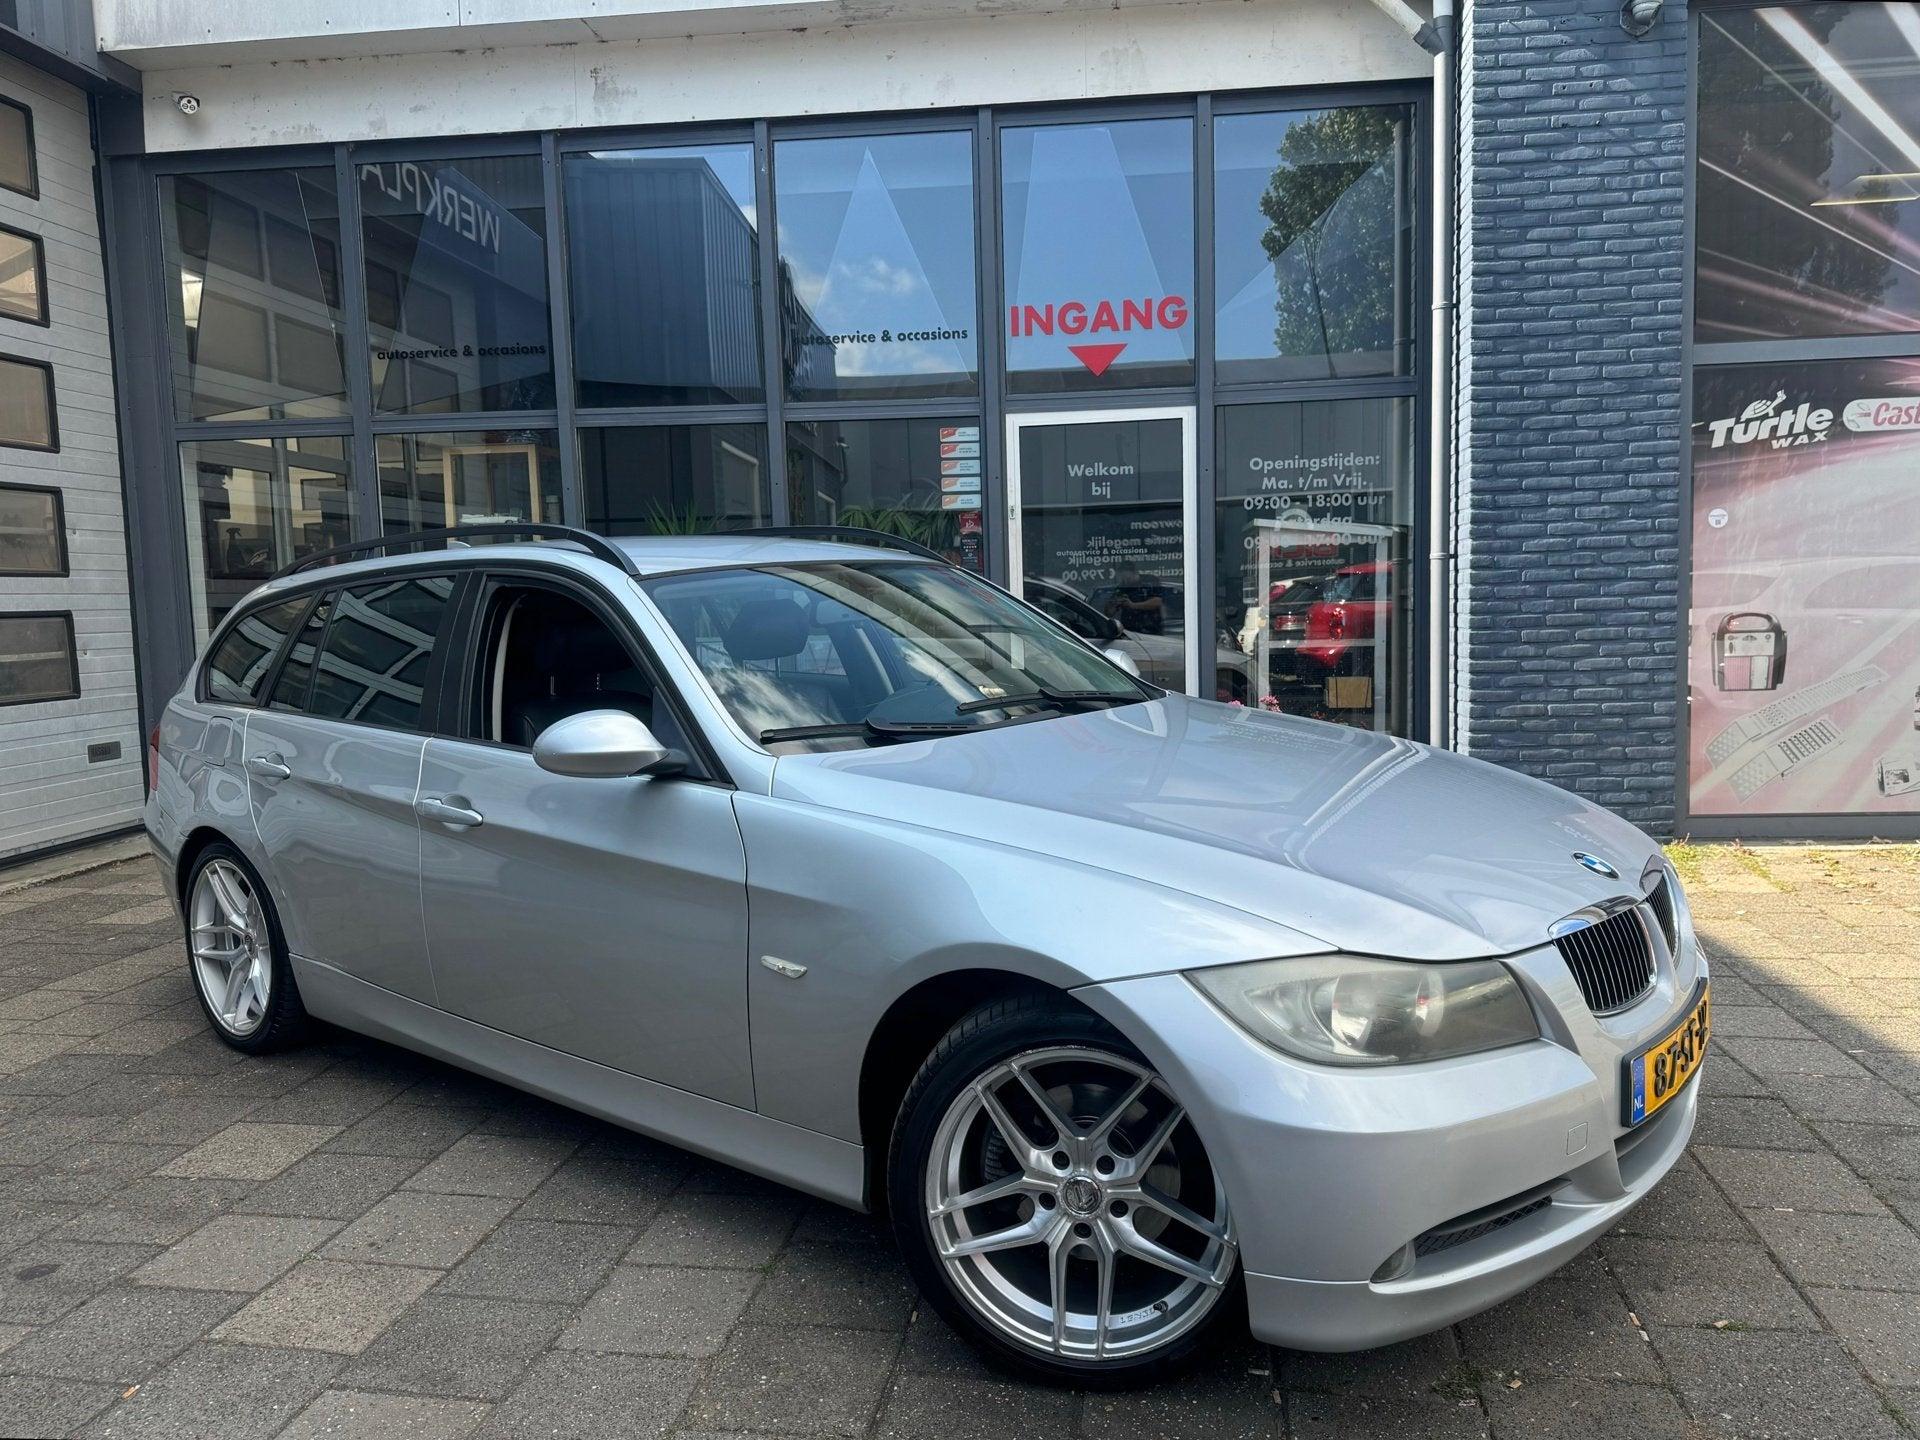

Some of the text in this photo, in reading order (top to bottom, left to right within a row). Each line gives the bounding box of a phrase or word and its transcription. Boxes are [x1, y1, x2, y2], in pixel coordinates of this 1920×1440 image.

[1010, 296, 1188, 337] INGANG
[794, 327, 968, 346] autoservice & occasions
[377, 343, 546, 360] autoservice & occasions
[1708, 402, 1834, 449] Turtle
[1771, 430, 1829, 450] WAX
[1067, 462, 1134, 477] Welkom
[1249, 452, 1380, 473] Openingstijden:
[1091, 482, 1111, 498] bij
[1261, 472, 1367, 491] Ma. t/m Vrij.
[1243, 496, 1291, 511] 09:00
[1306, 493, 1352, 508] 18:00
[1357, 493, 1385, 506] uur
[1111, 547, 1148, 555] occasions
[1633, 1095, 1644, 1112] NL
